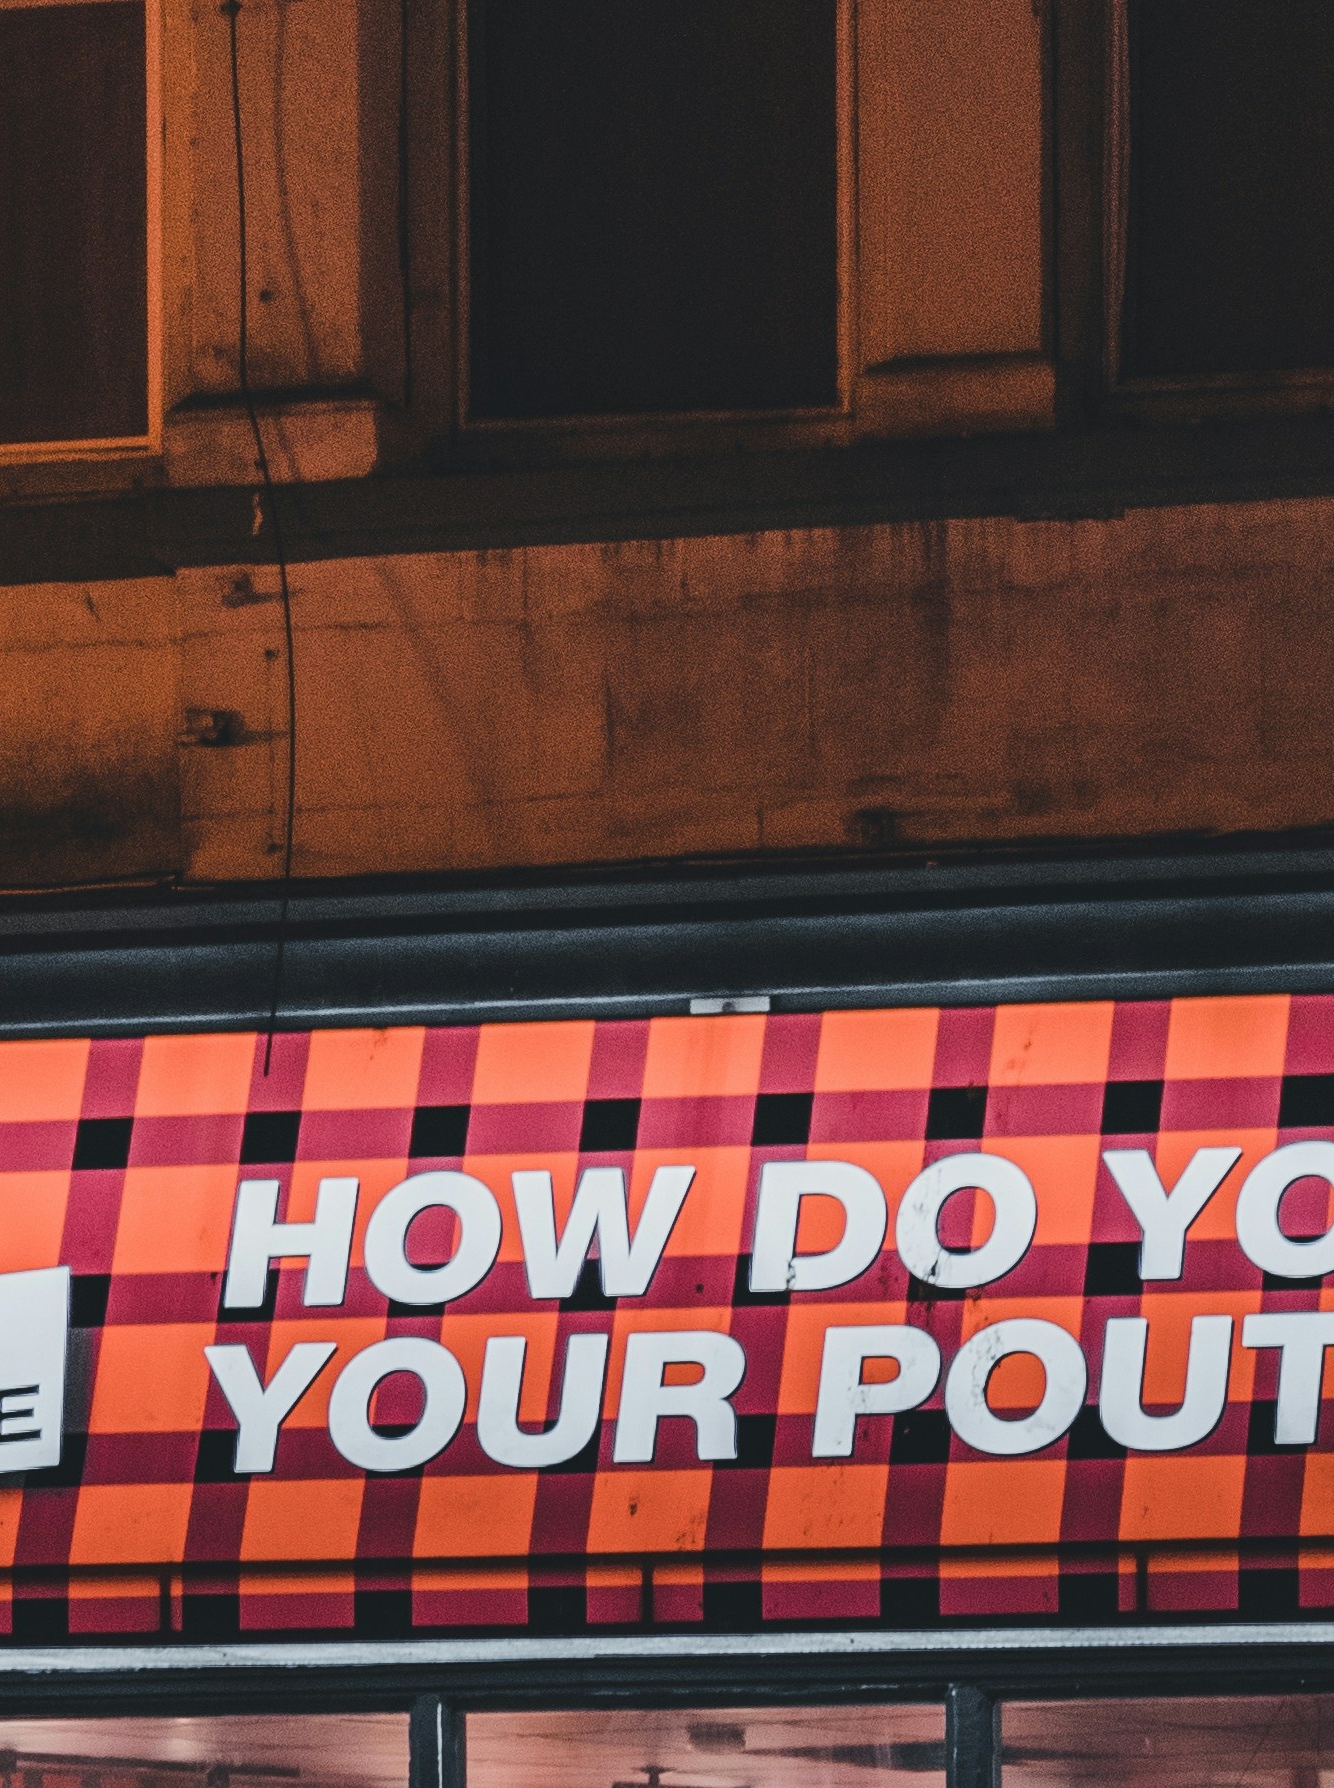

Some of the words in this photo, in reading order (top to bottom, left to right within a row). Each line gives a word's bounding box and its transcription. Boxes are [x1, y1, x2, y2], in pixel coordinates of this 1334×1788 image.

[223, 1165, 696, 1308] HOW
[748, 1151, 1038, 1293] DO
[204, 1330, 748, 1474] YOUR
